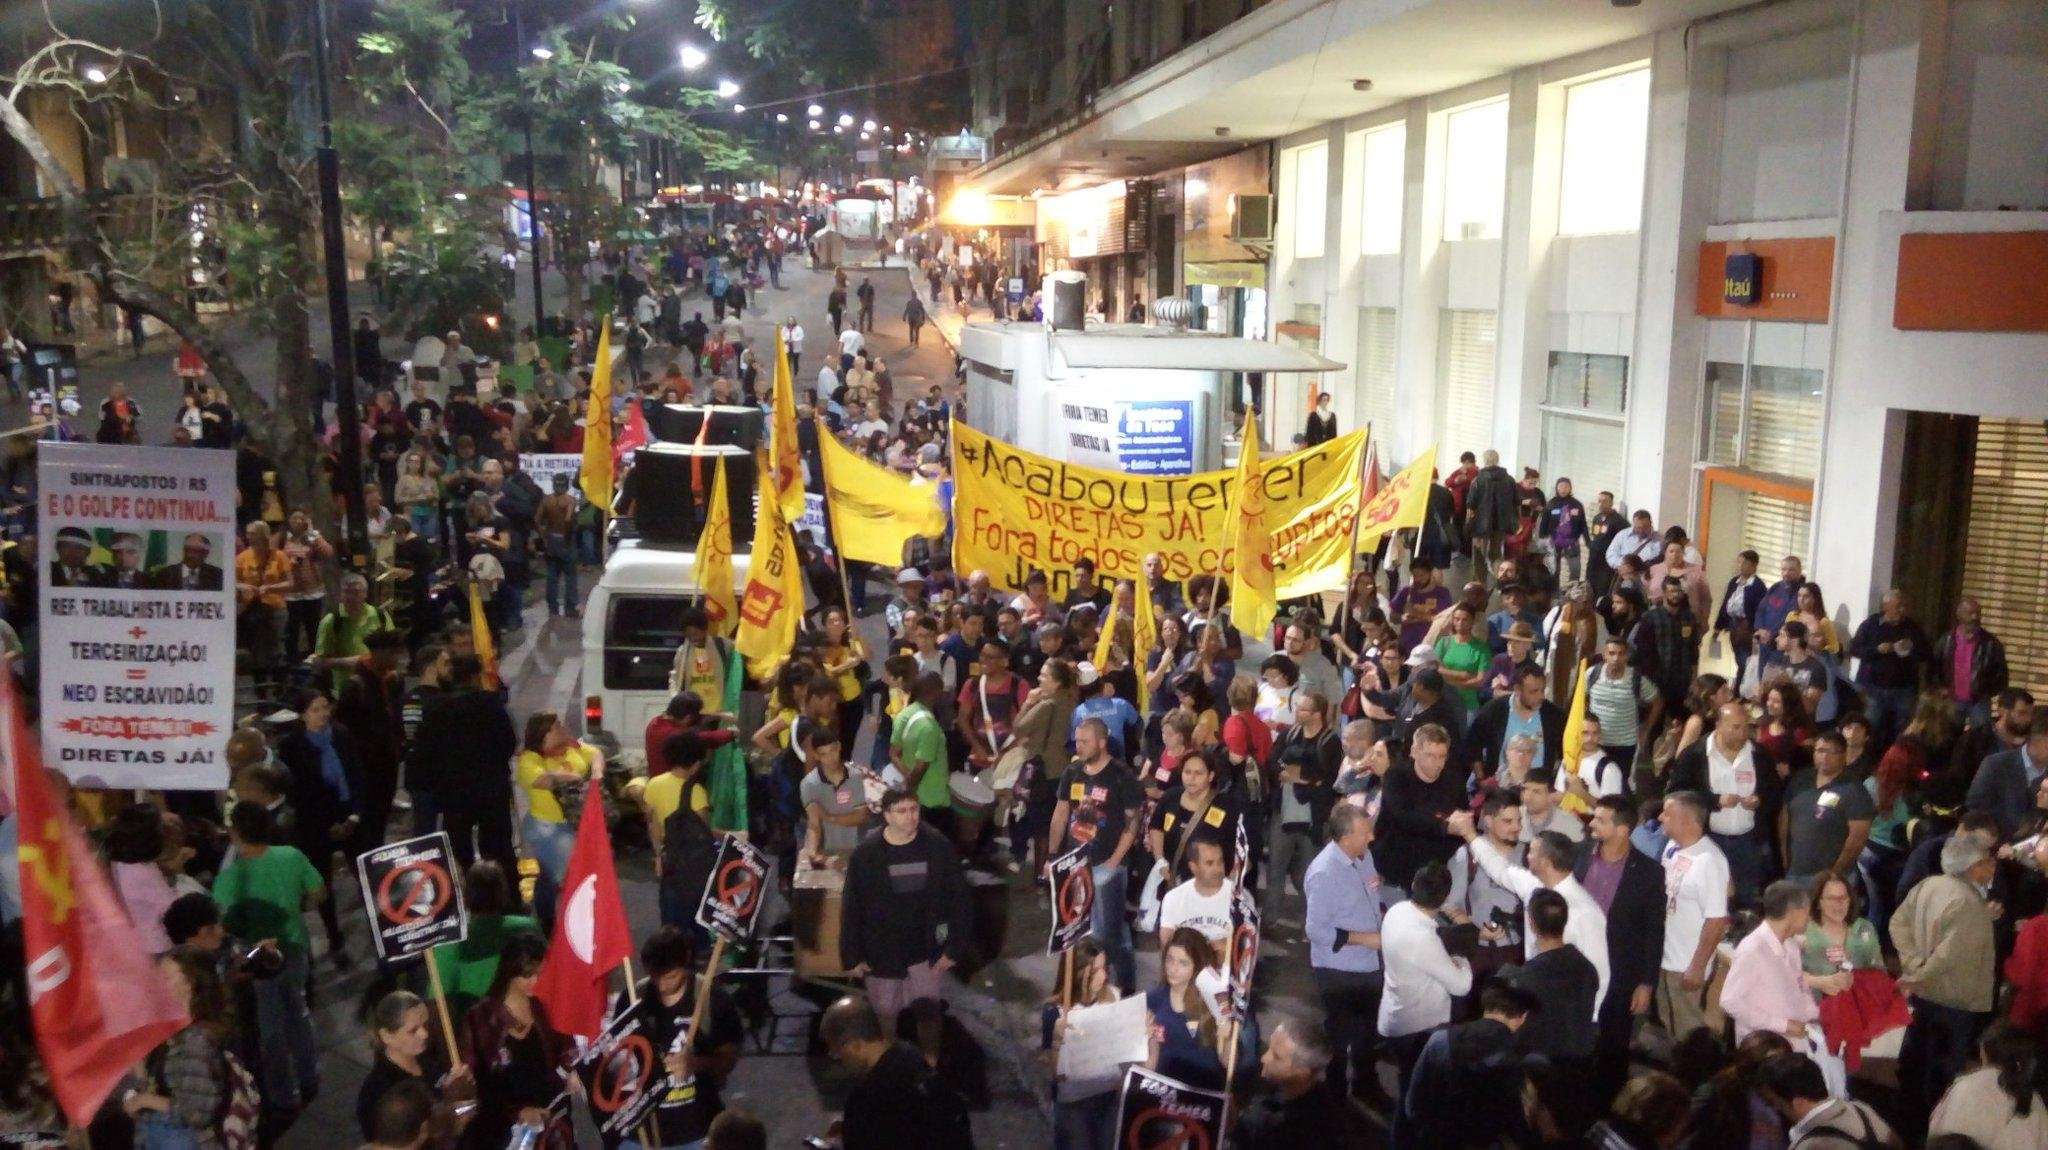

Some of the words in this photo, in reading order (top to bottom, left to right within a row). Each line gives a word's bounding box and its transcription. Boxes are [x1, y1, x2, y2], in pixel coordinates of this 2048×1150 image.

[1724, 277, 1751, 298] Itaú
[69, 472, 178, 490] SINTRAPOSTOS
[188, 477, 208, 491] RS
[960, 439, 1327, 515] #AcabouTeer
[48, 494, 58, 517] E
[63, 494, 75, 517] O
[79, 495, 130, 519] GOLPE
[1022, 495, 1145, 540] DIRETAS
[1156, 510, 1206, 543] JA!
[972, 507, 1038, 561] Fora
[1049, 529, 1141, 574] todos
[82, 598, 171, 619] TRABALHISTA
[175, 601, 184, 619] E
[187, 601, 226, 620] PREV.
[69, 641, 208, 667] TERCEIRIZAÇÃO!
[62, 684, 97, 702] NEO
[103, 683, 215, 705] ESCRAVIDÃO!
[60, 748, 166, 764] DIRETAS
[174, 747, 215, 764] JÁ!
